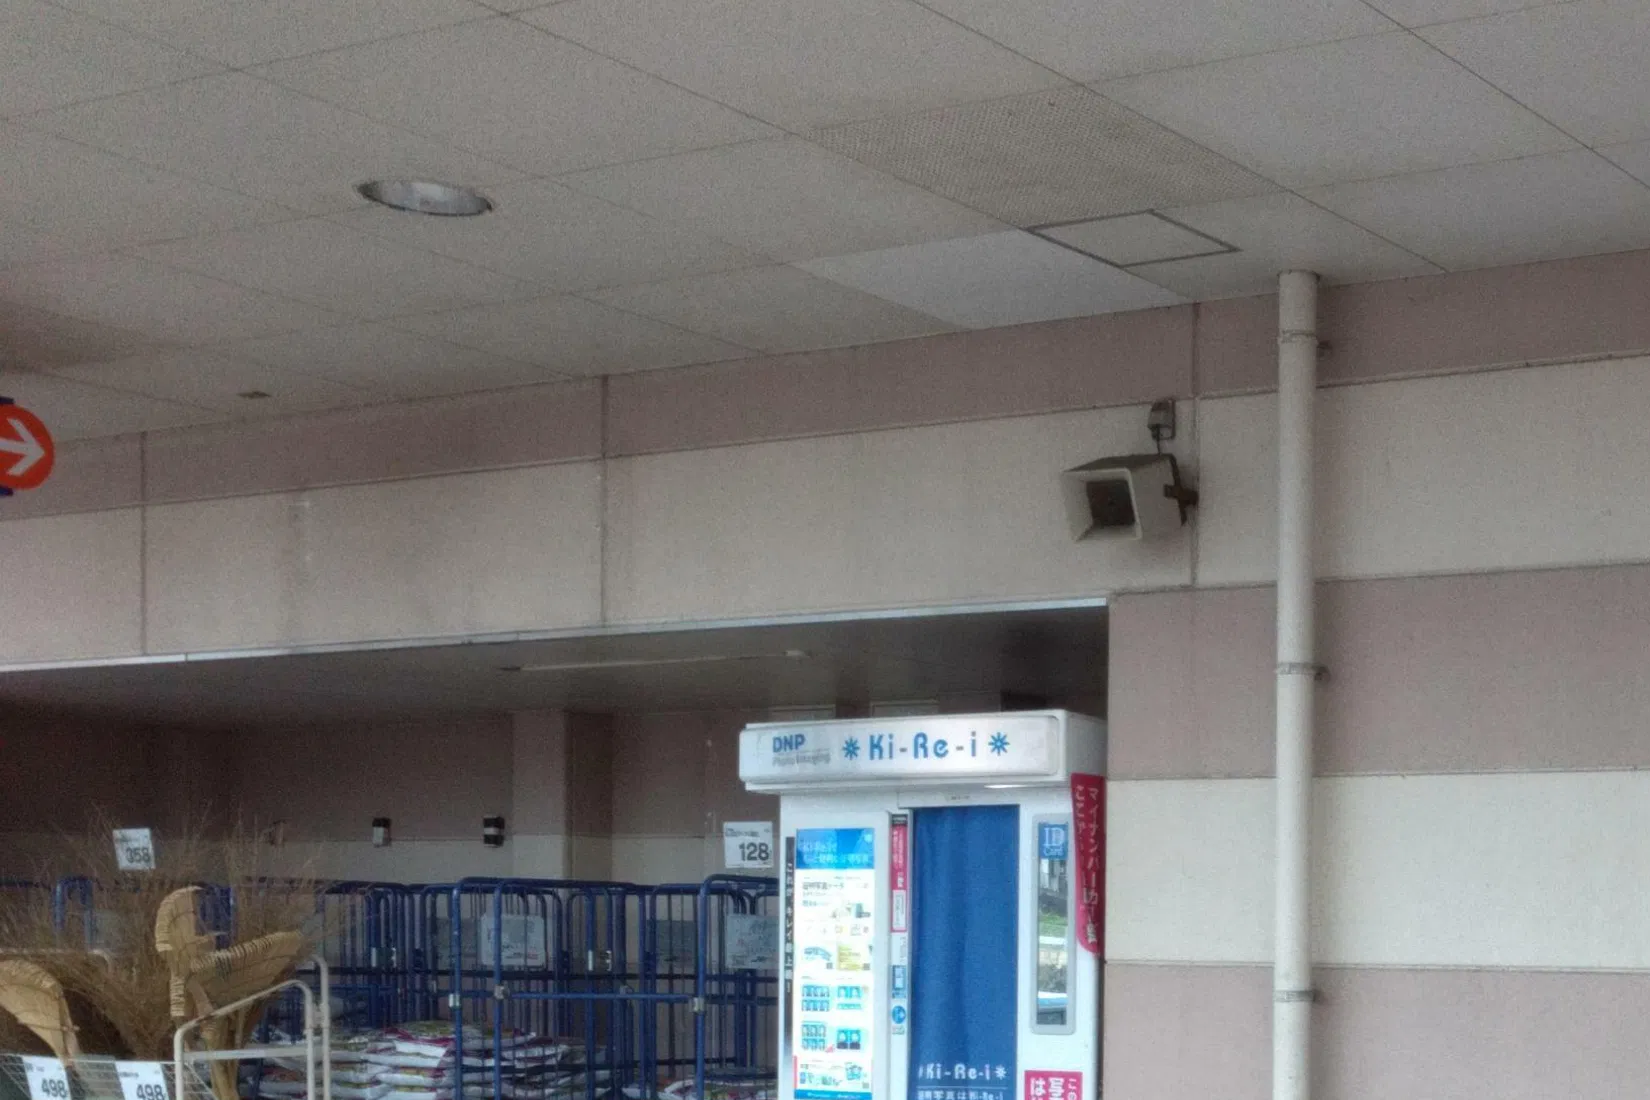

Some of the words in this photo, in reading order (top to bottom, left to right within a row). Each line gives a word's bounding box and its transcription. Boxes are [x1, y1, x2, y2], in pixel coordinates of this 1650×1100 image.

[773, 734, 806, 752] DNP
[738, 842, 769, 861] 128
[41, 1079, 67, 1099] 498
